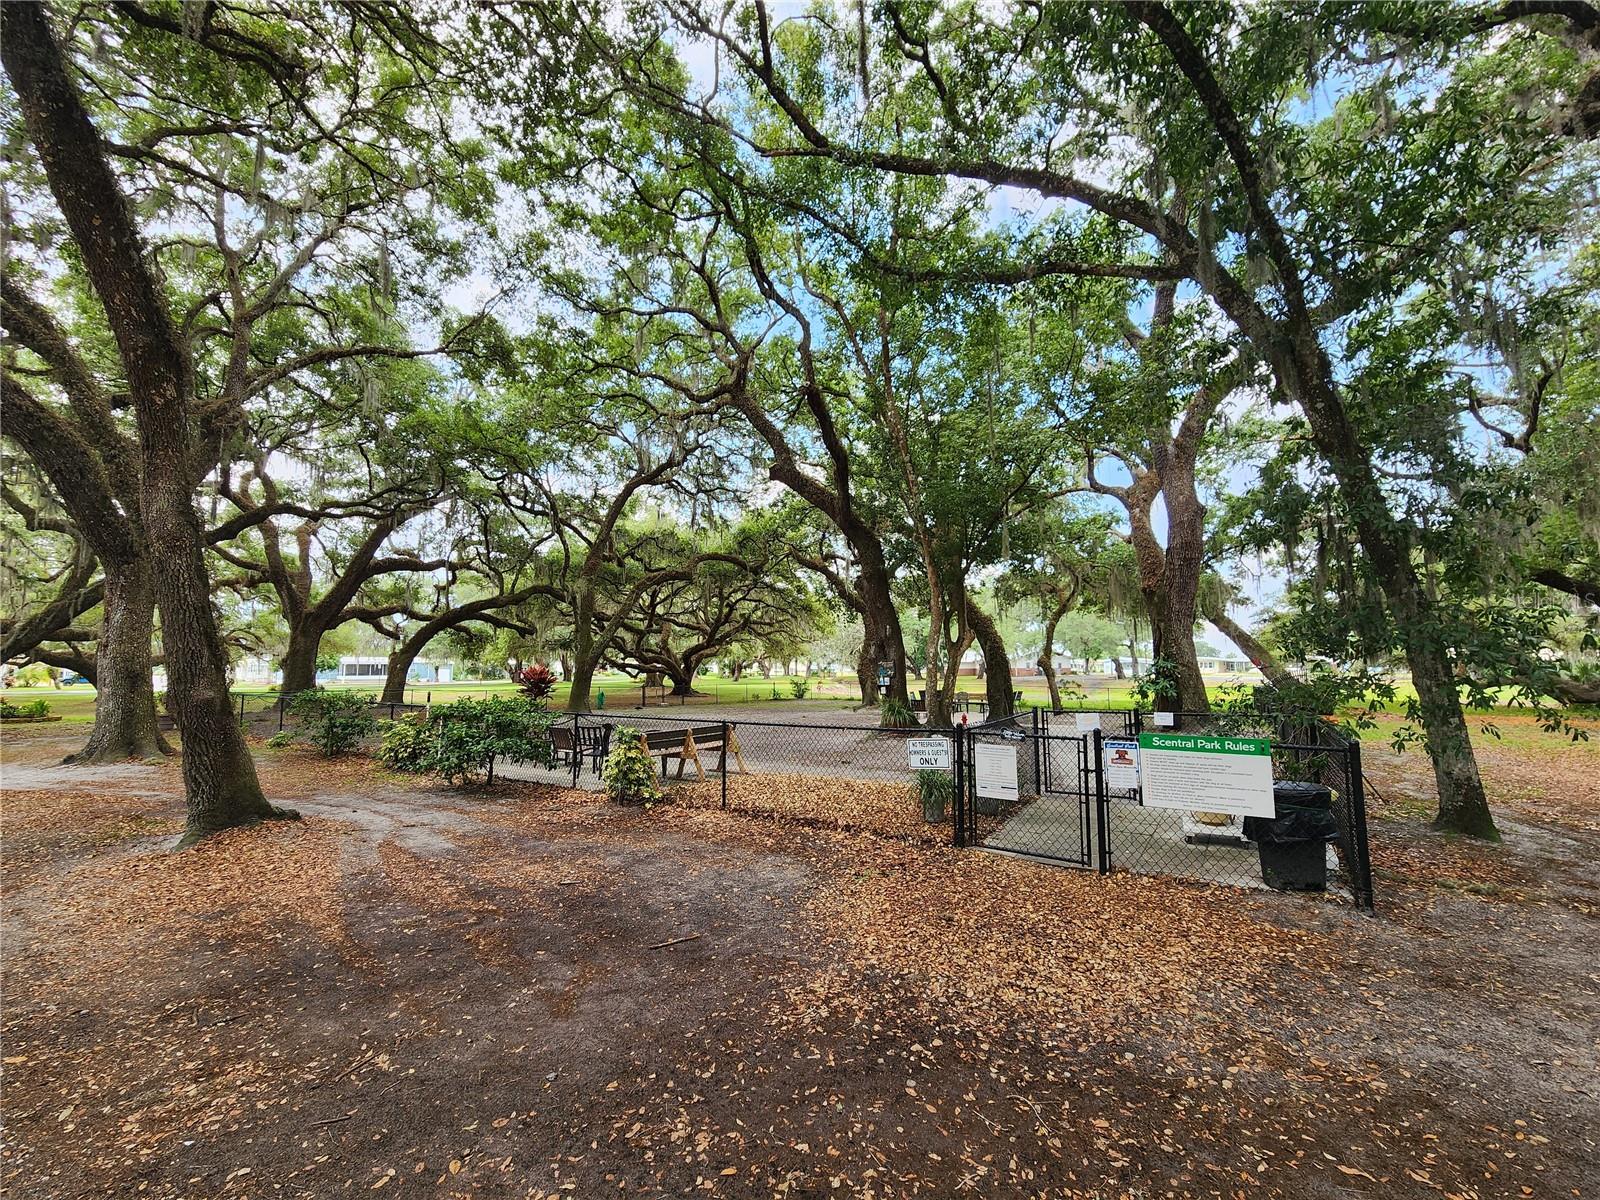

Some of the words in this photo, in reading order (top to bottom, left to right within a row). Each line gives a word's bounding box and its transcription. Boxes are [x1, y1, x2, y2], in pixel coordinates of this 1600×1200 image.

[1152, 737, 1194, 748] Scentral
[1197, 739, 1221, 749] Park
[1225, 741, 1255, 751] Rules
[920, 757, 938, 765] ONLY
